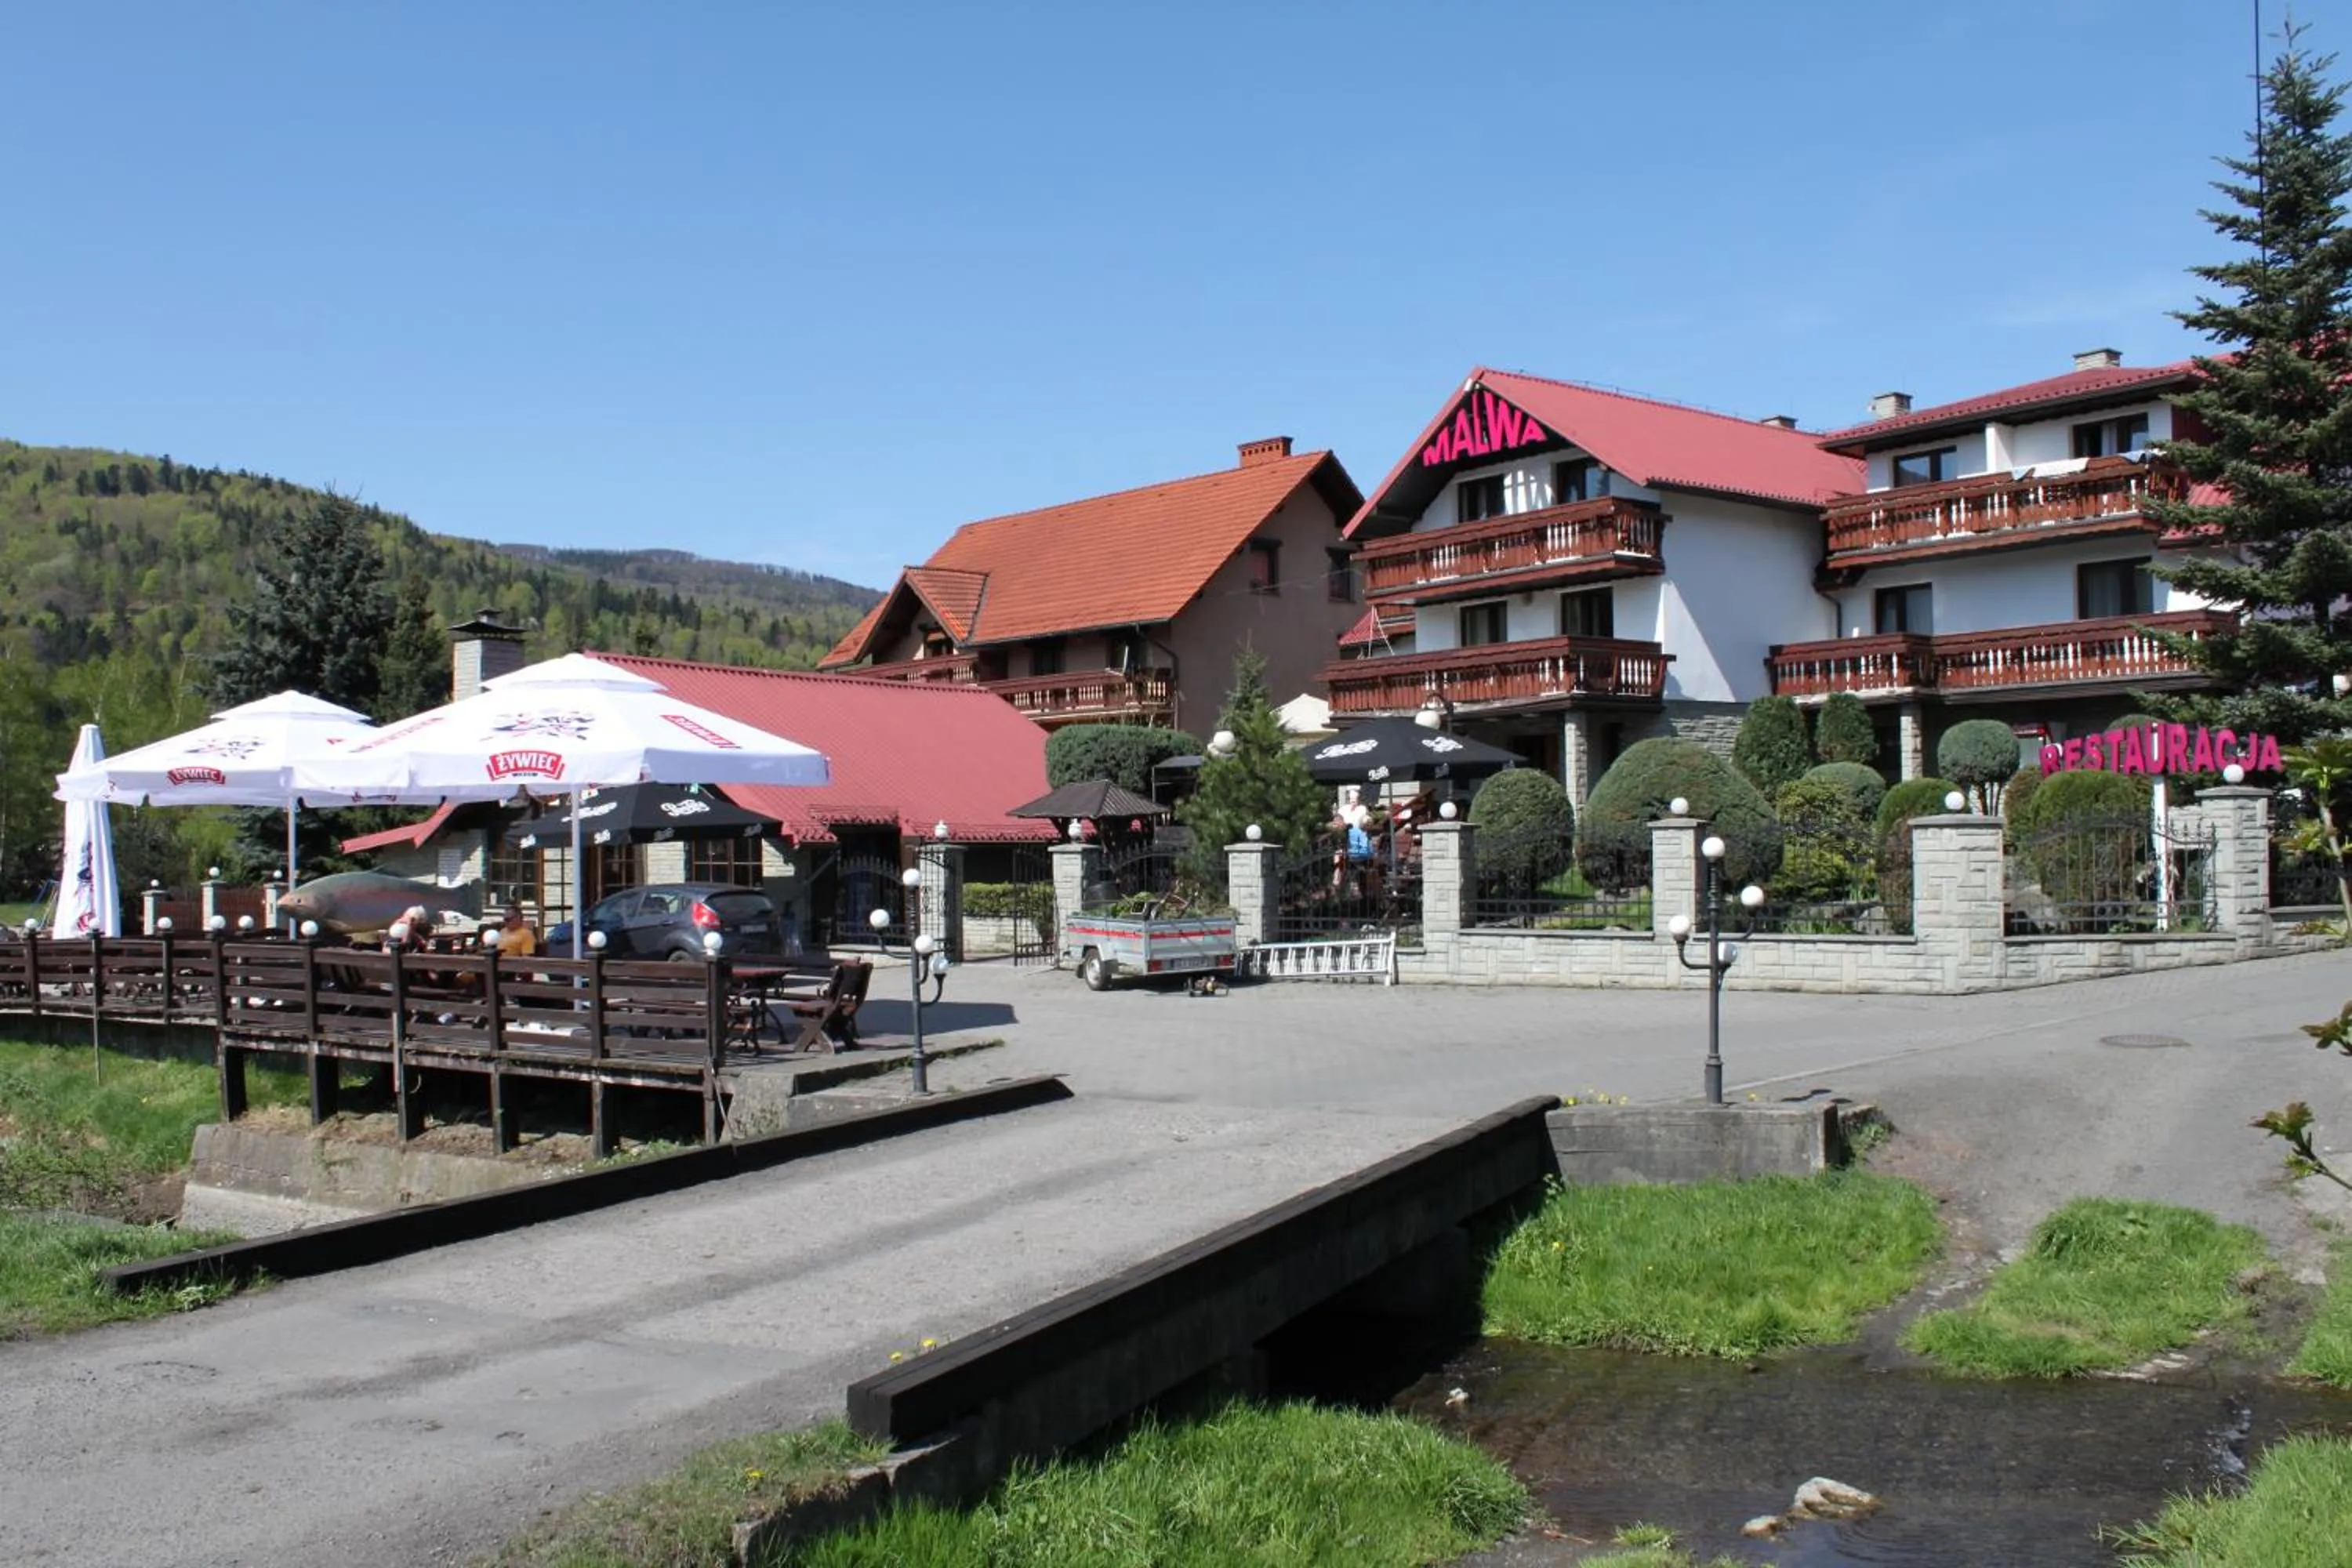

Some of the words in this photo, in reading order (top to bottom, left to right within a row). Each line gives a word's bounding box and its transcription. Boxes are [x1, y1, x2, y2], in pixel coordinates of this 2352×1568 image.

[1423, 390, 1548, 467] MALWA
[495, 752, 558, 772] ŻYWIEC
[2040, 721, 2283, 778] RESTAURACJA
